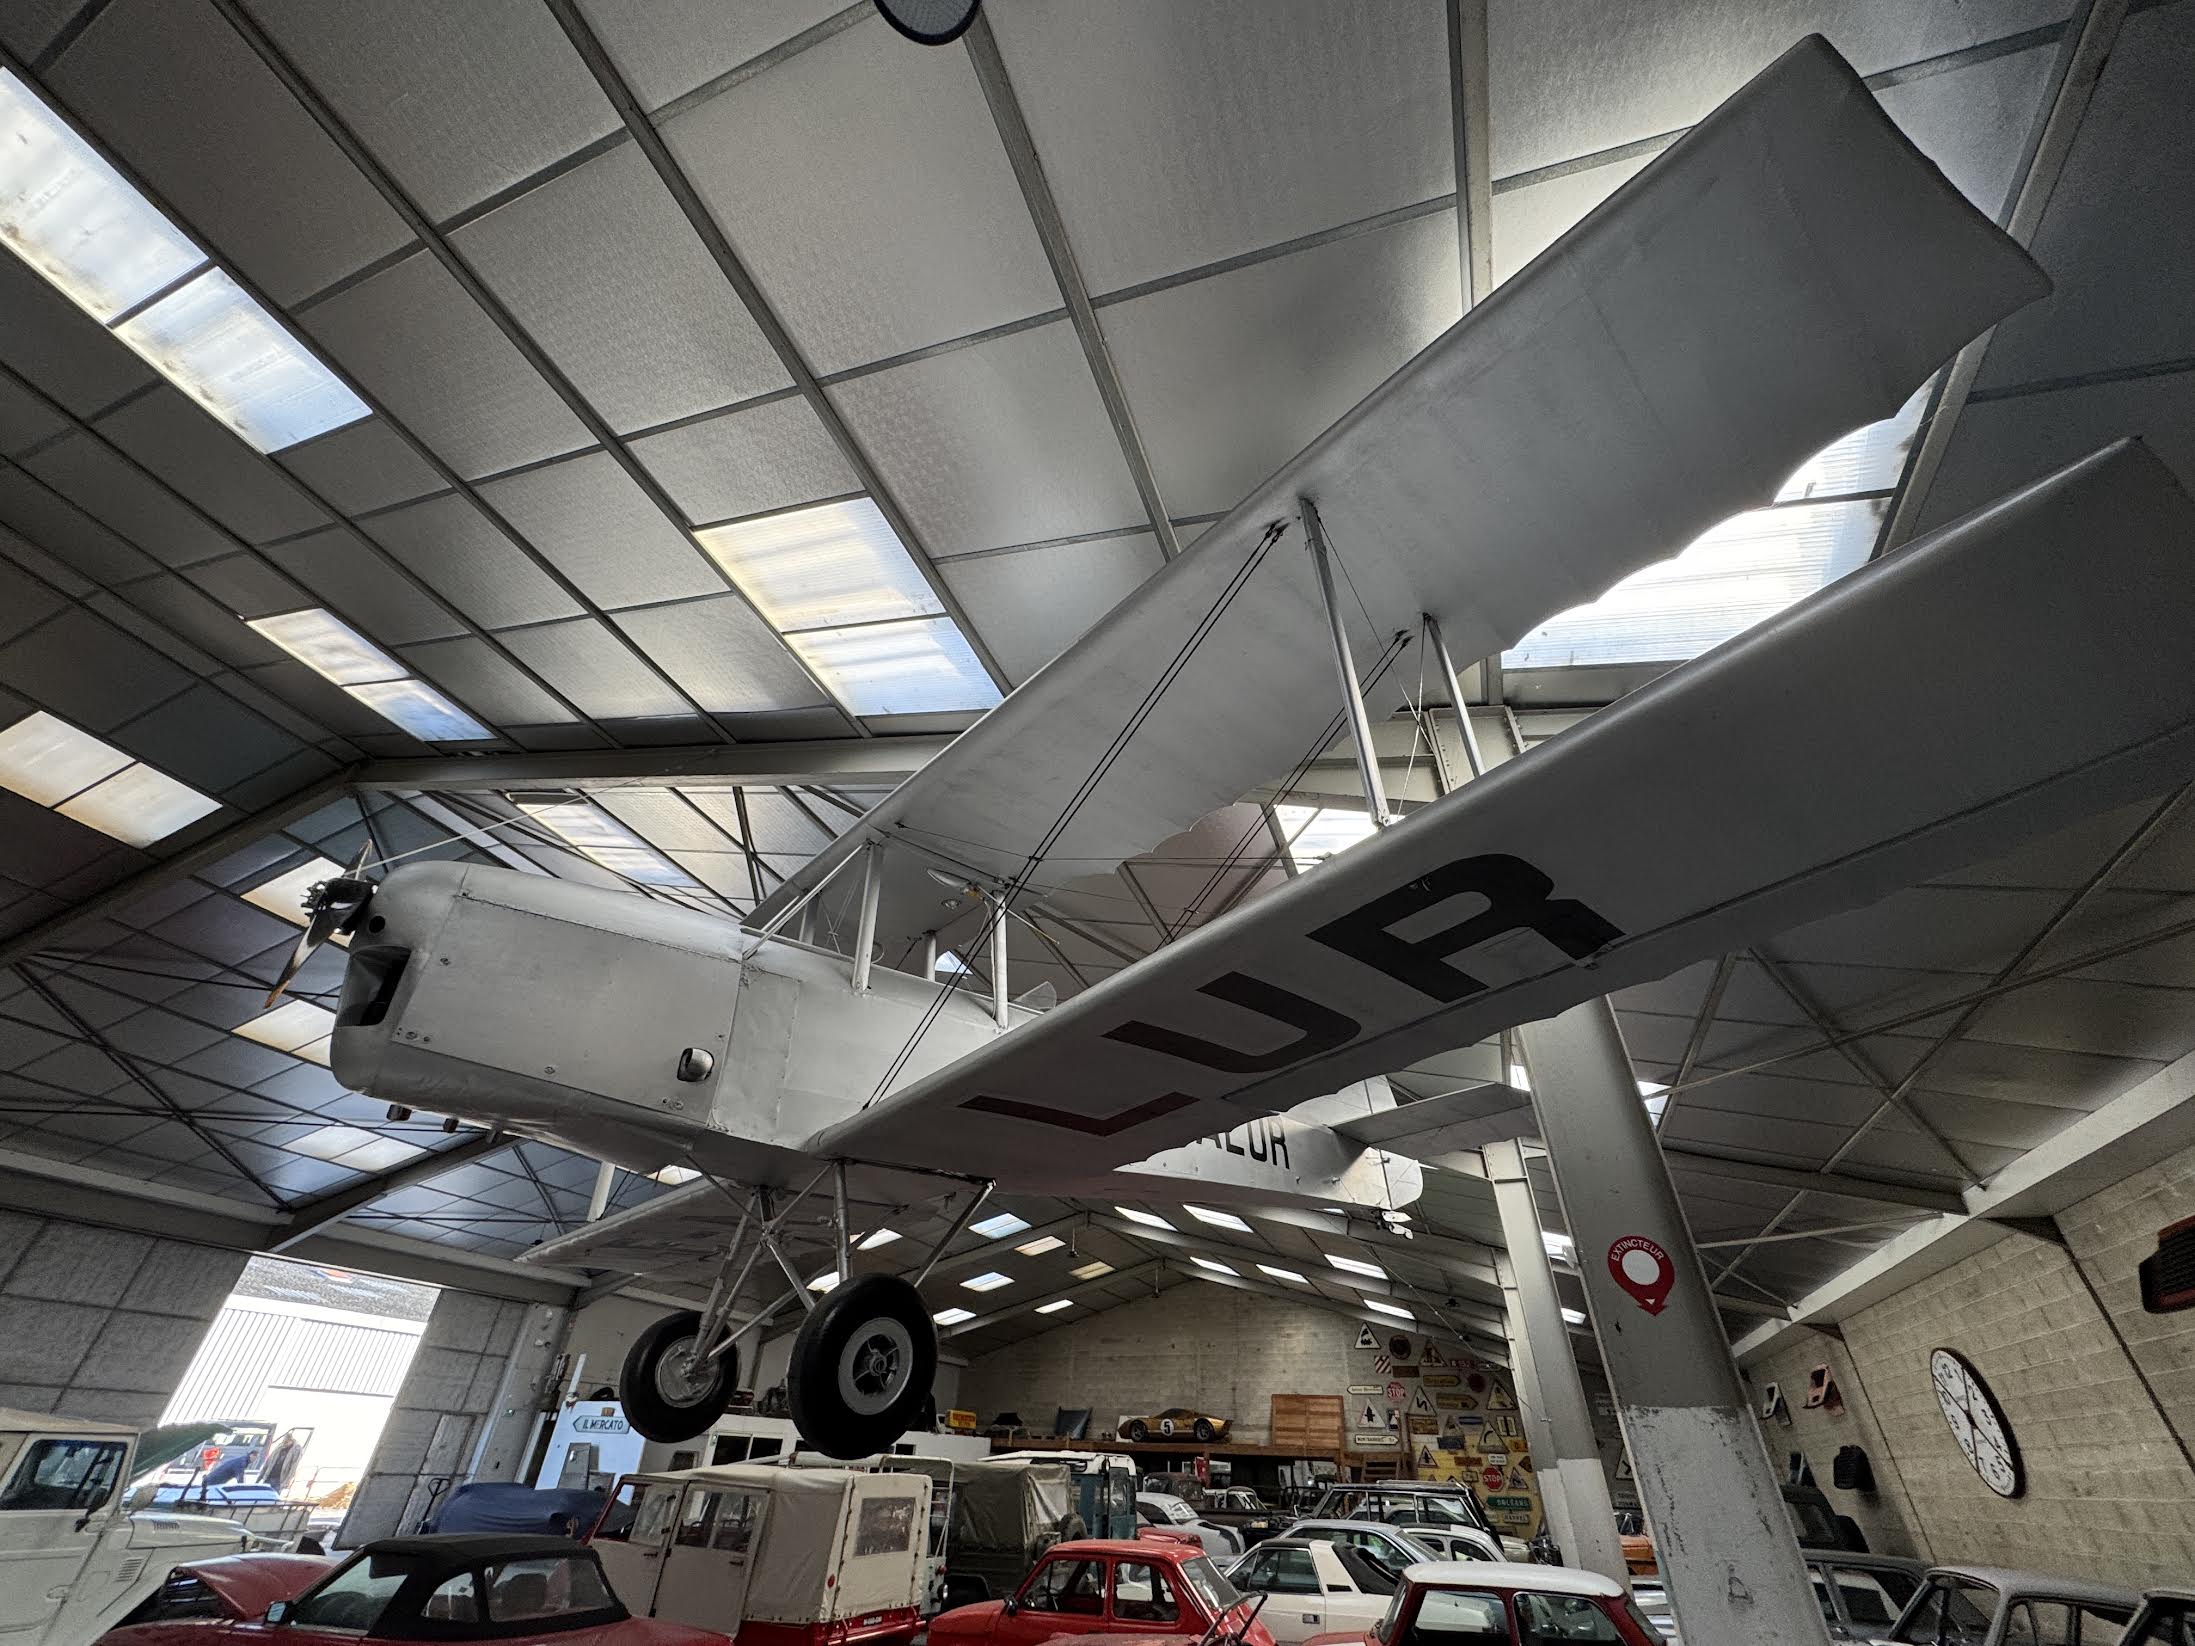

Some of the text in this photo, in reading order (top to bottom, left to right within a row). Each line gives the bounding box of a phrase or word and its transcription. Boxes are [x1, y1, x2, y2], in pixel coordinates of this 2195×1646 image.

[1611, 1239, 1664, 1262] EXTINCTEUR
[1387, 1388, 1405, 1399] STOP
[582, 1419, 623, 1430] IL MERCATO
[1164, 1421, 1170, 1434] 5
[1483, 1474, 1501, 1483] STOP
